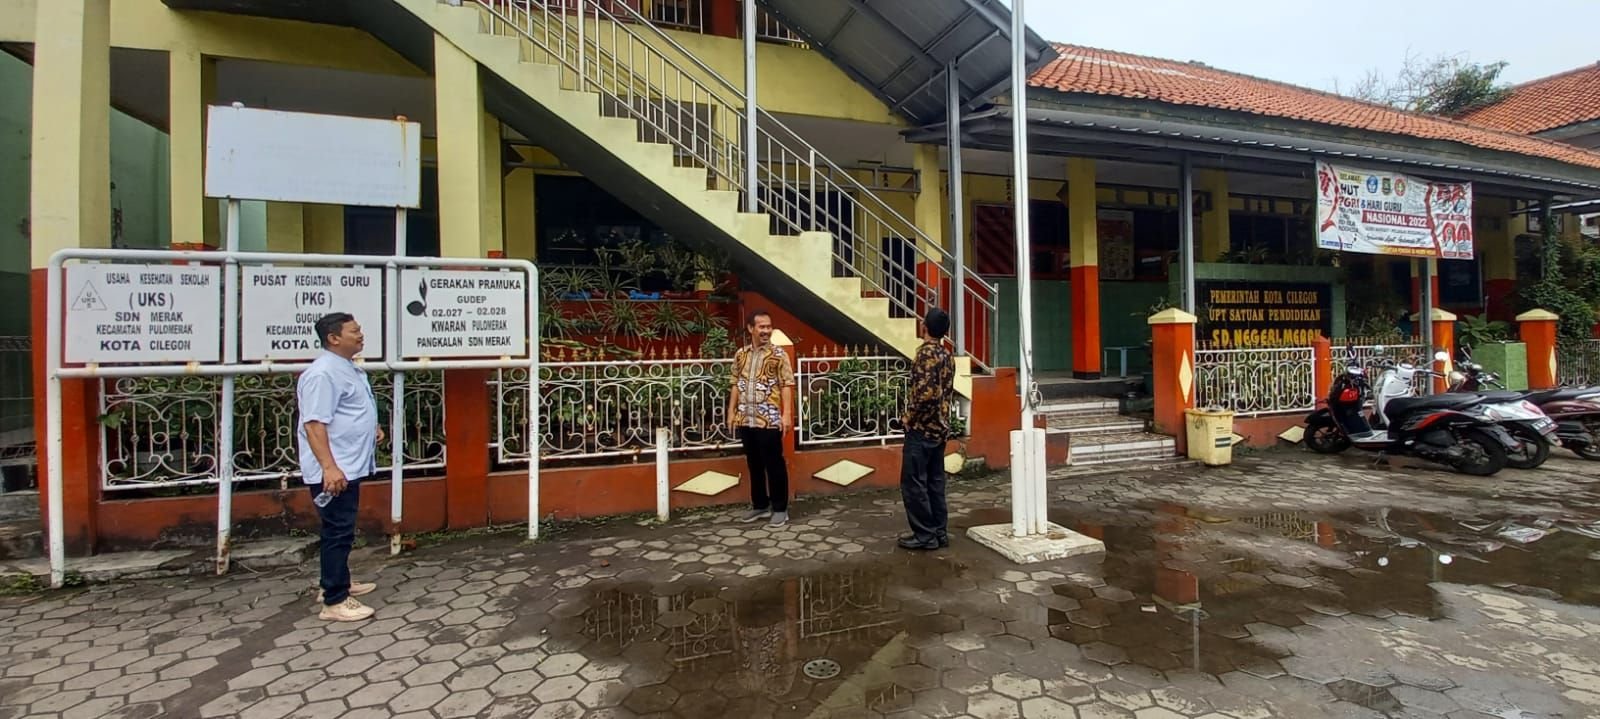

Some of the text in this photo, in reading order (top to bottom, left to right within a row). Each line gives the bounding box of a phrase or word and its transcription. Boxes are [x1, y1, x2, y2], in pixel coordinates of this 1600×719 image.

[1340, 183, 1359, 196] HUT
[1366, 199, 1382, 210] HARI
[1384, 201, 1402, 212] GURU
[1366, 212, 1407, 226] NASIONAL
[1409, 217, 1427, 227] 2022
[106, 273, 209, 285] USAHA KESEHATAN SEKOLAH
[253, 275, 370, 287] PUSAT KEGIATAN GURU
[430, 278, 521, 290] GERAKAN PRAMUKA
[457, 296, 487, 304] GUDEP
[1210, 290, 1318, 304] PEMERINTAH KOTA CILEGON
[115, 311, 183, 322] SDN MERAK
[431, 308, 463, 317] 02.027
[476, 307, 507, 315] 02.028
[1209, 308, 1321, 321] UPT SATUAN PENDIDIKAN
[96, 324, 193, 335] KECAMATAN PULOMERAK
[266, 325, 312, 336] KECAMATAN
[431, 320, 508, 332] KWARAN PULOMERAK
[417, 336, 511, 348] PANGKALAN SDN MERAK
[1212, 329, 1230, 347] SD
[100, 340, 191, 351] KOTA CILEGON
[271, 340, 309, 350] KOTA
